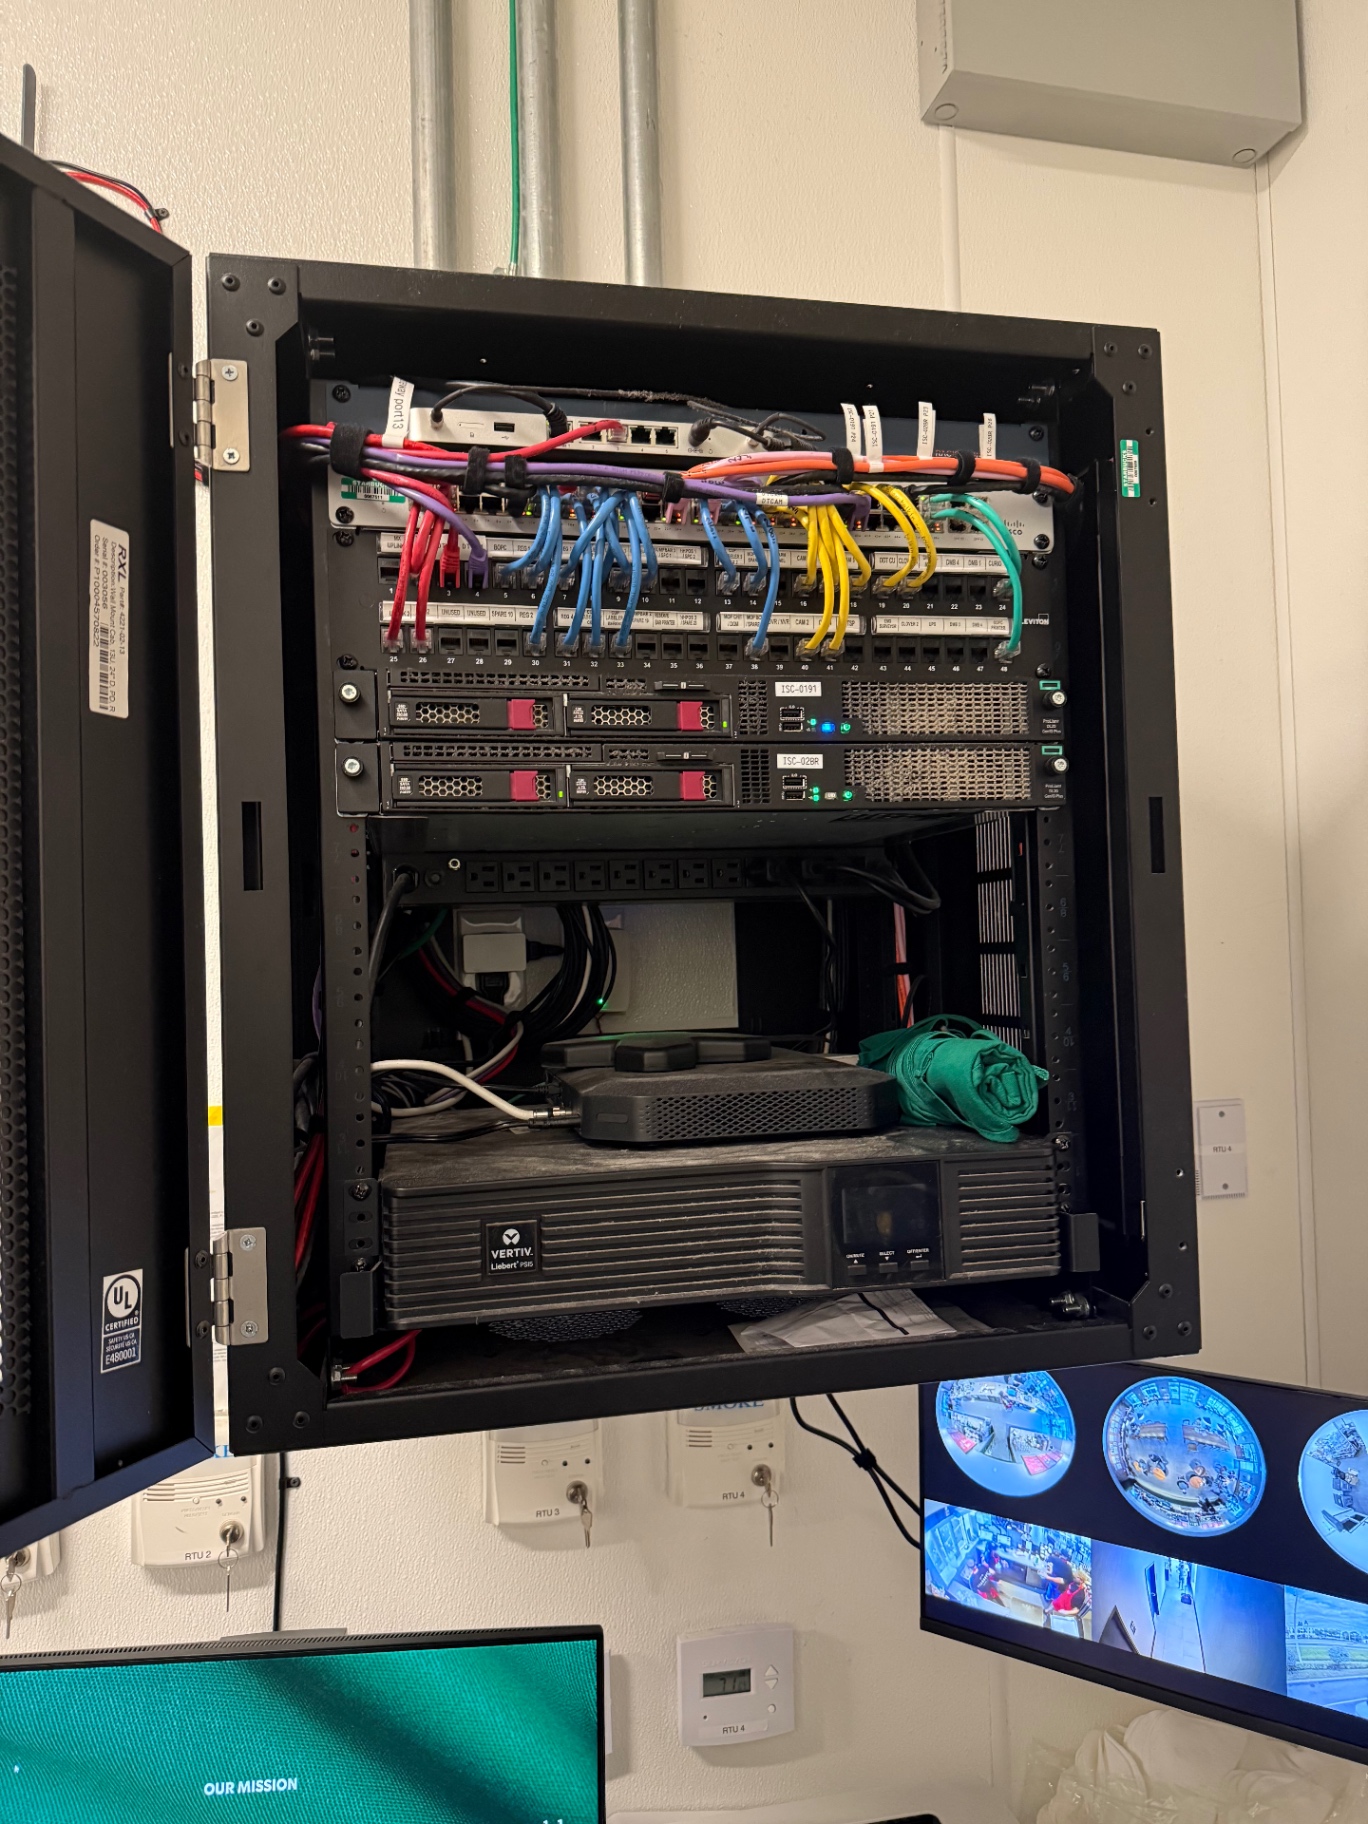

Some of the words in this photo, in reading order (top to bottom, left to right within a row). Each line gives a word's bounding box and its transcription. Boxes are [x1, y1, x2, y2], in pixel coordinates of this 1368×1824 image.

[118, 543, 127, 582] RXL
[781, 685, 817, 693] ISC-0191
[783, 756, 820, 765] ISC-02BR
[491, 1247, 532, 1259] VERTIV
[113, 1285, 132, 1310] UL
[105, 1316, 139, 1331] CERTIFIED
[105, 1346, 136, 1365] E480001
[722, 1492, 737, 1500] RTU
[738, 1491, 745, 1499] 4
[536, 1509, 553, 1518] RTU
[554, 1508, 560, 1516] 3
[184, 1552, 203, 1560] RTU
[205, 1551, 212, 1559] 2
[722, 1726, 738, 1734] RTU
[203, 1781, 235, 1796] OUR
[237, 1777, 297, 1794] MISSION
